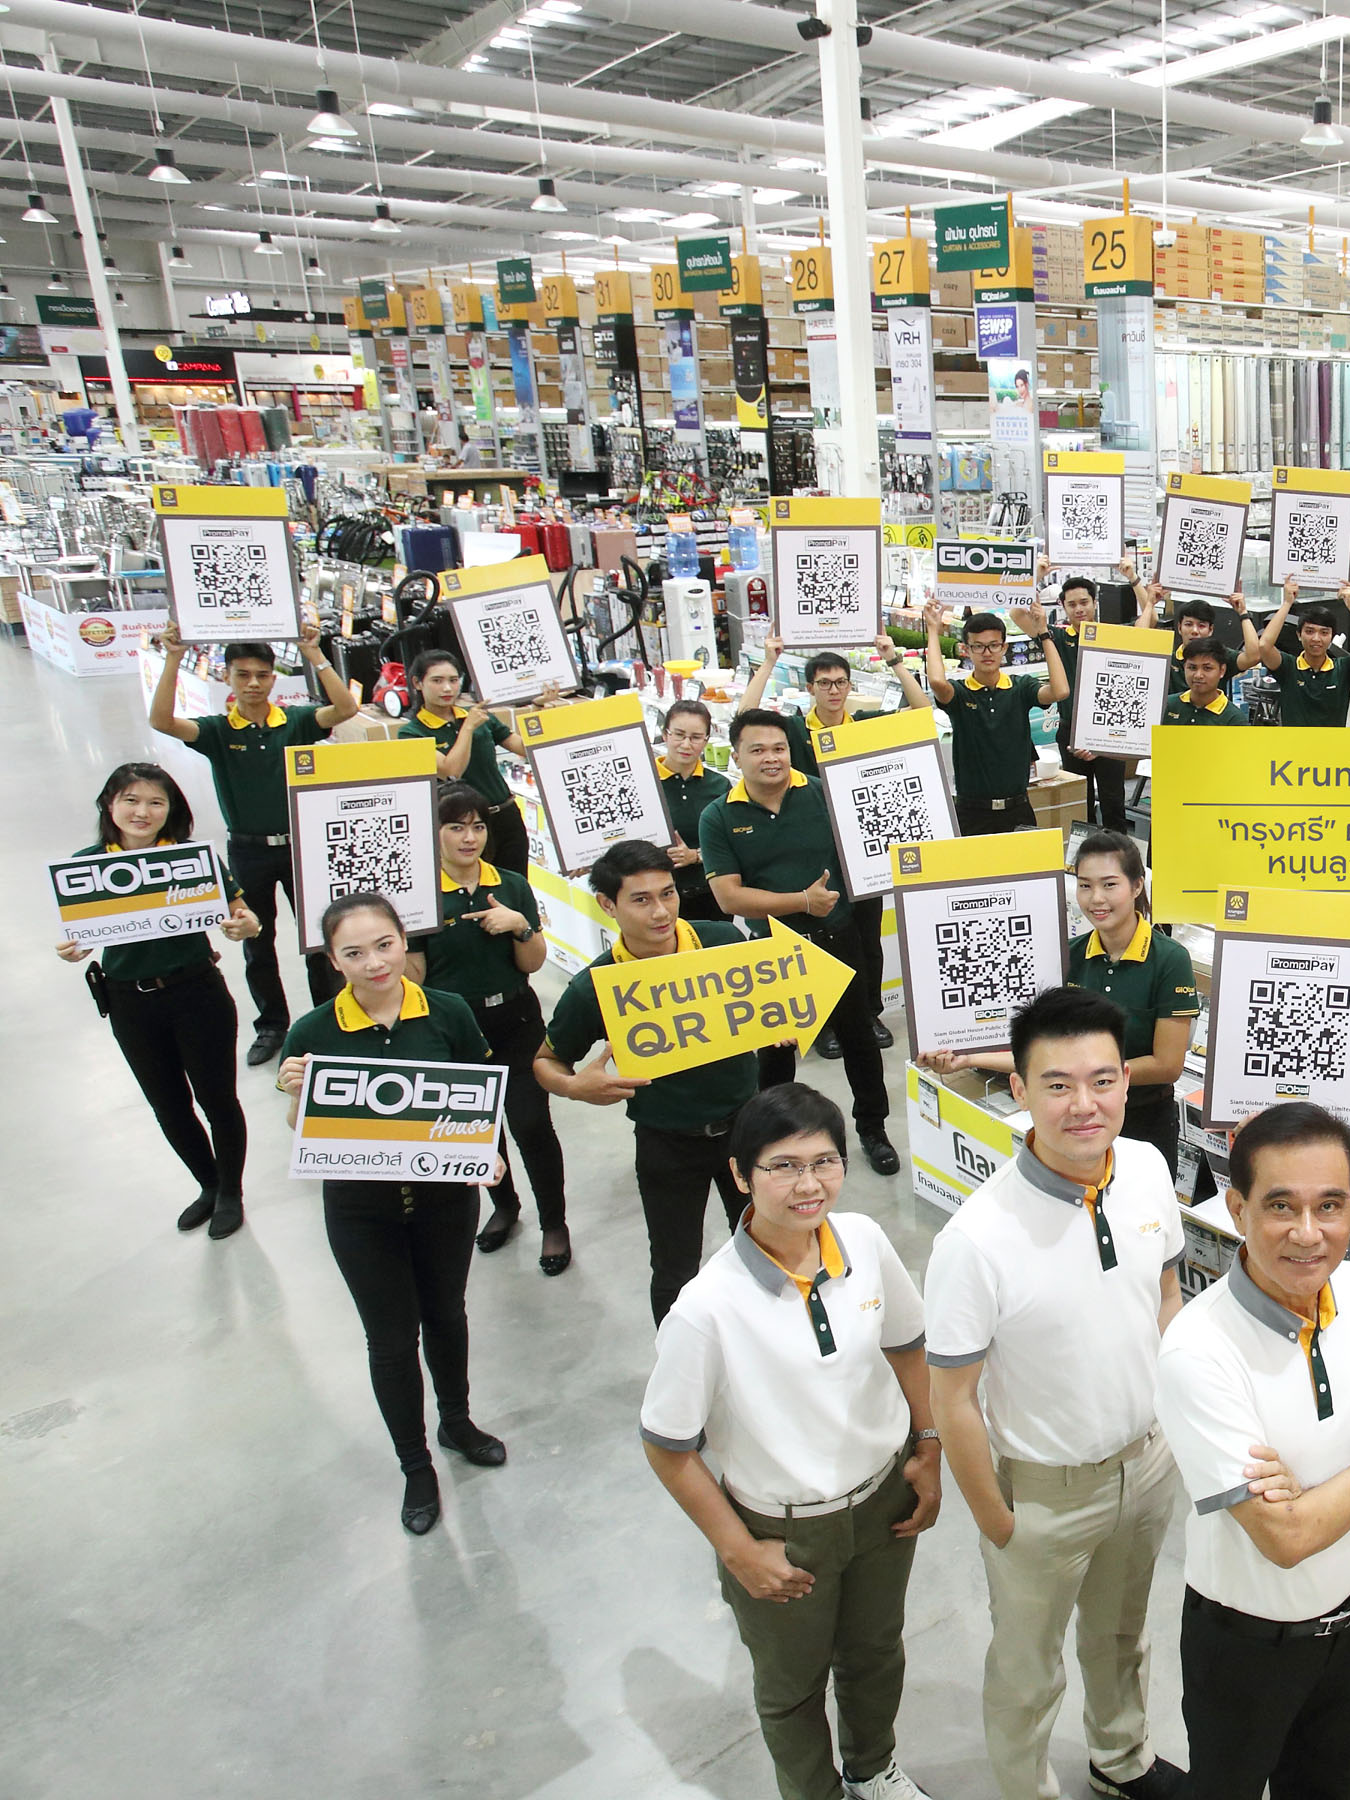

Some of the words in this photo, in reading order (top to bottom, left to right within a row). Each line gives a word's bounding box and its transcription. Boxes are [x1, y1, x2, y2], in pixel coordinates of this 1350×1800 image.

[1091, 229, 1127, 272] 25
[795, 258, 819, 291] 28
[879, 250, 905, 285] 27
[597, 280, 612, 307] 31
[654, 272, 673, 300] 30
[545, 284, 559, 311] 32
[990, 318, 1013, 334] WSP
[895, 332, 921, 345] VRH
[178, 363, 222, 372] CAMPANA
[911, 359, 922, 368] 304
[808, 538, 848, 547] PromptPay
[938, 546, 1032, 571] Global
[999, 571, 1032, 585] House
[937, 588, 988, 600] โกลบอลเฮ้าส์
[1008, 597, 1033, 606] 1160
[860, 762, 904, 778] PromptPay
[341, 796, 393, 811] PromptPay
[55, 850, 213, 897] Global
[166, 881, 216, 905] House
[952, 896, 1012, 911] PromptPay
[65, 919, 152, 941] โกลบอลเฮ้าส์
[185, 913, 224, 930] 1160
[1271, 957, 1336, 973] PromptPay
[612, 944, 808, 1017] Krungsri
[627, 1011, 711, 1058] QR
[724, 993, 818, 1036] Pay
[948, 1028, 966, 1036] Global
[313, 1068, 497, 1115] Global
[1277, 1084, 1309, 1095] Global
[429, 1115, 491, 1140] House
[299, 1148, 403, 1166] โกลบอลเฮ้าส์
[441, 1161, 489, 1177] 1160
